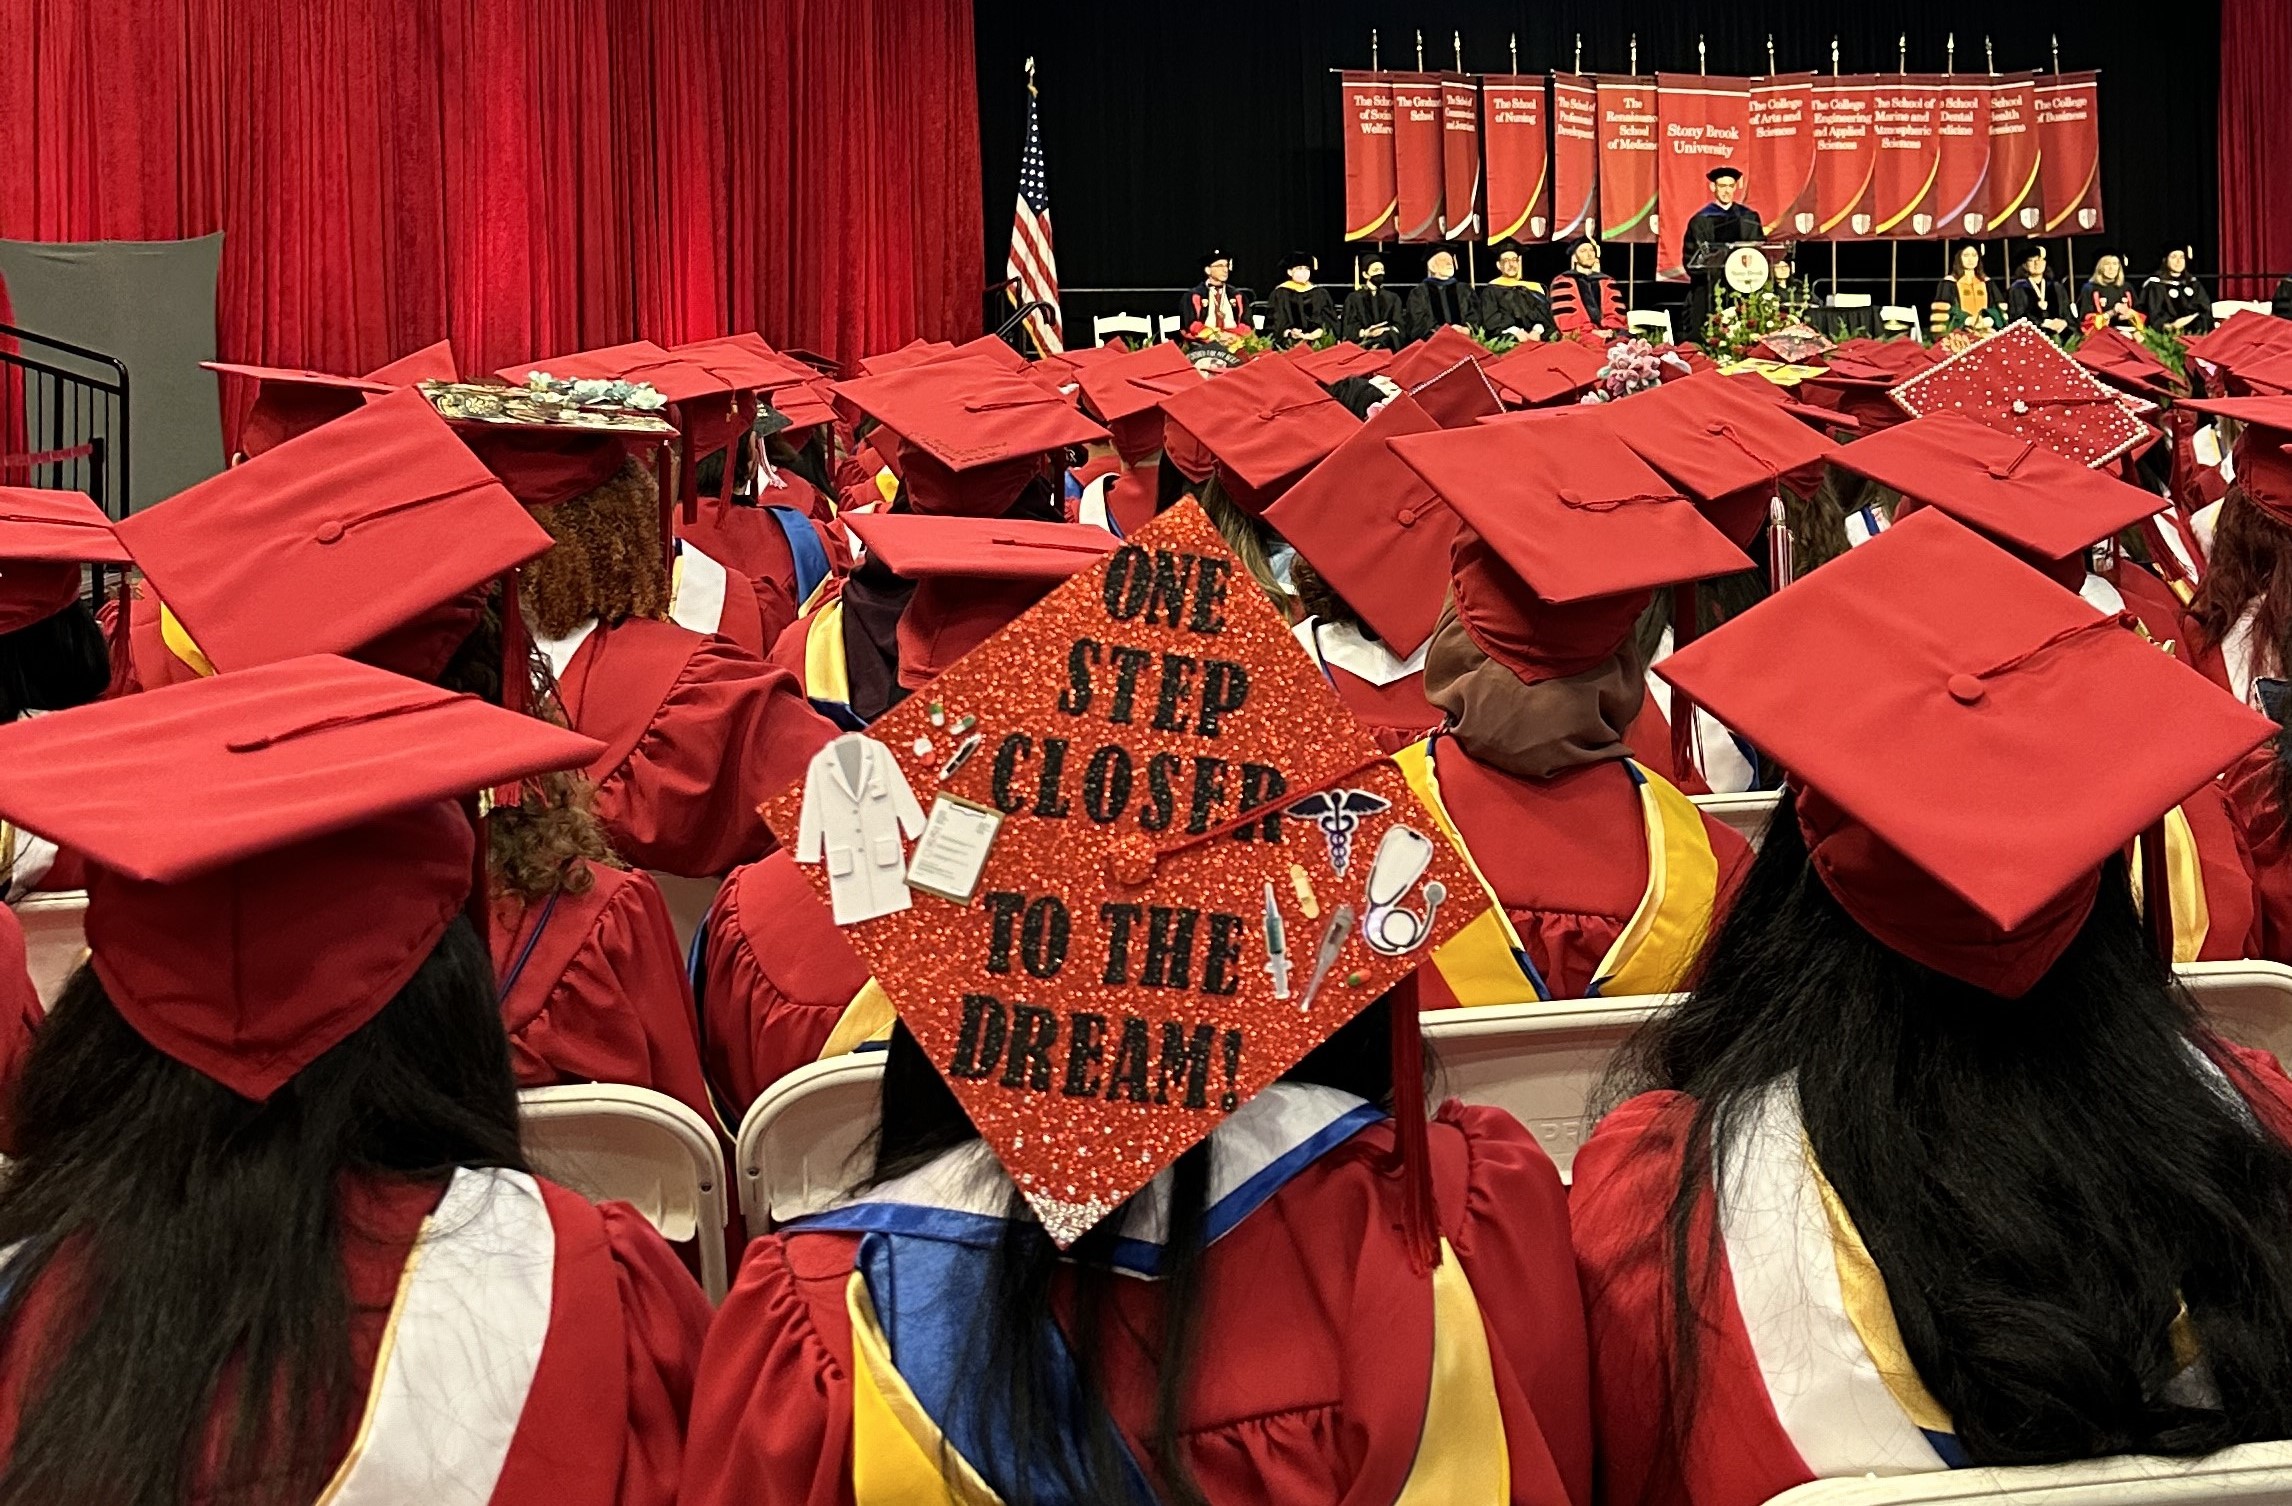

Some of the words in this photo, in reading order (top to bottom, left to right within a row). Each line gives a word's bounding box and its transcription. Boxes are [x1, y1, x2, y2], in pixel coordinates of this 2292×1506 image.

[1354, 95, 1372, 106] The
[1373, 95, 1393, 107] Scho
[1396, 96, 1412, 107] The
[1493, 98, 1511, 109] The
[1512, 98, 1536, 110] School
[1623, 97, 1643, 109] The
[1767, 97, 1803, 111] College
[1829, 98, 1866, 112] College
[1891, 96, 1923, 109] School
[1924, 98, 1936, 109] of
[1945, 97, 1978, 109] School
[1991, 95, 2023, 109] School
[2052, 96, 2088, 109] College
[1360, 108, 1370, 120] of
[1410, 109, 1434, 121] School
[1495, 112, 1506, 123] of
[1506, 112, 1536, 125] Nursing
[1749, 113, 1761, 125] of
[1761, 113, 1782, 124] Arts
[1782, 110, 1802, 122] and
[1814, 112, 1872, 124] Engineering
[1874, 111, 1910, 121] Marine
[1910, 111, 1930, 121] and
[1940, 111, 1974, 122] Dental
[2045, 110, 2088, 123] Business
[1619, 125, 1649, 136] School
[1667, 123, 1704, 139] Stony
[1706, 124, 1739, 140] Brook
[1756, 126, 1797, 138] Sciences
[1828, 125, 1866, 139] Applied
[1938, 123, 1974, 136] edicine
[1607, 138, 1619, 150] of
[1673, 140, 1733, 158] University
[1817, 139, 1857, 150] Sciences
[1881, 137, 1921, 149] Sciences
[1104, 545, 1231, 634] ONE
[1058, 638, 1248, 737] STEP
[992, 733, 1287, 843] CLOSER
[985, 892, 1070, 979] TO
[1101, 902, 1243, 995] THE
[951, 993, 1242, 1113] DREAM!
